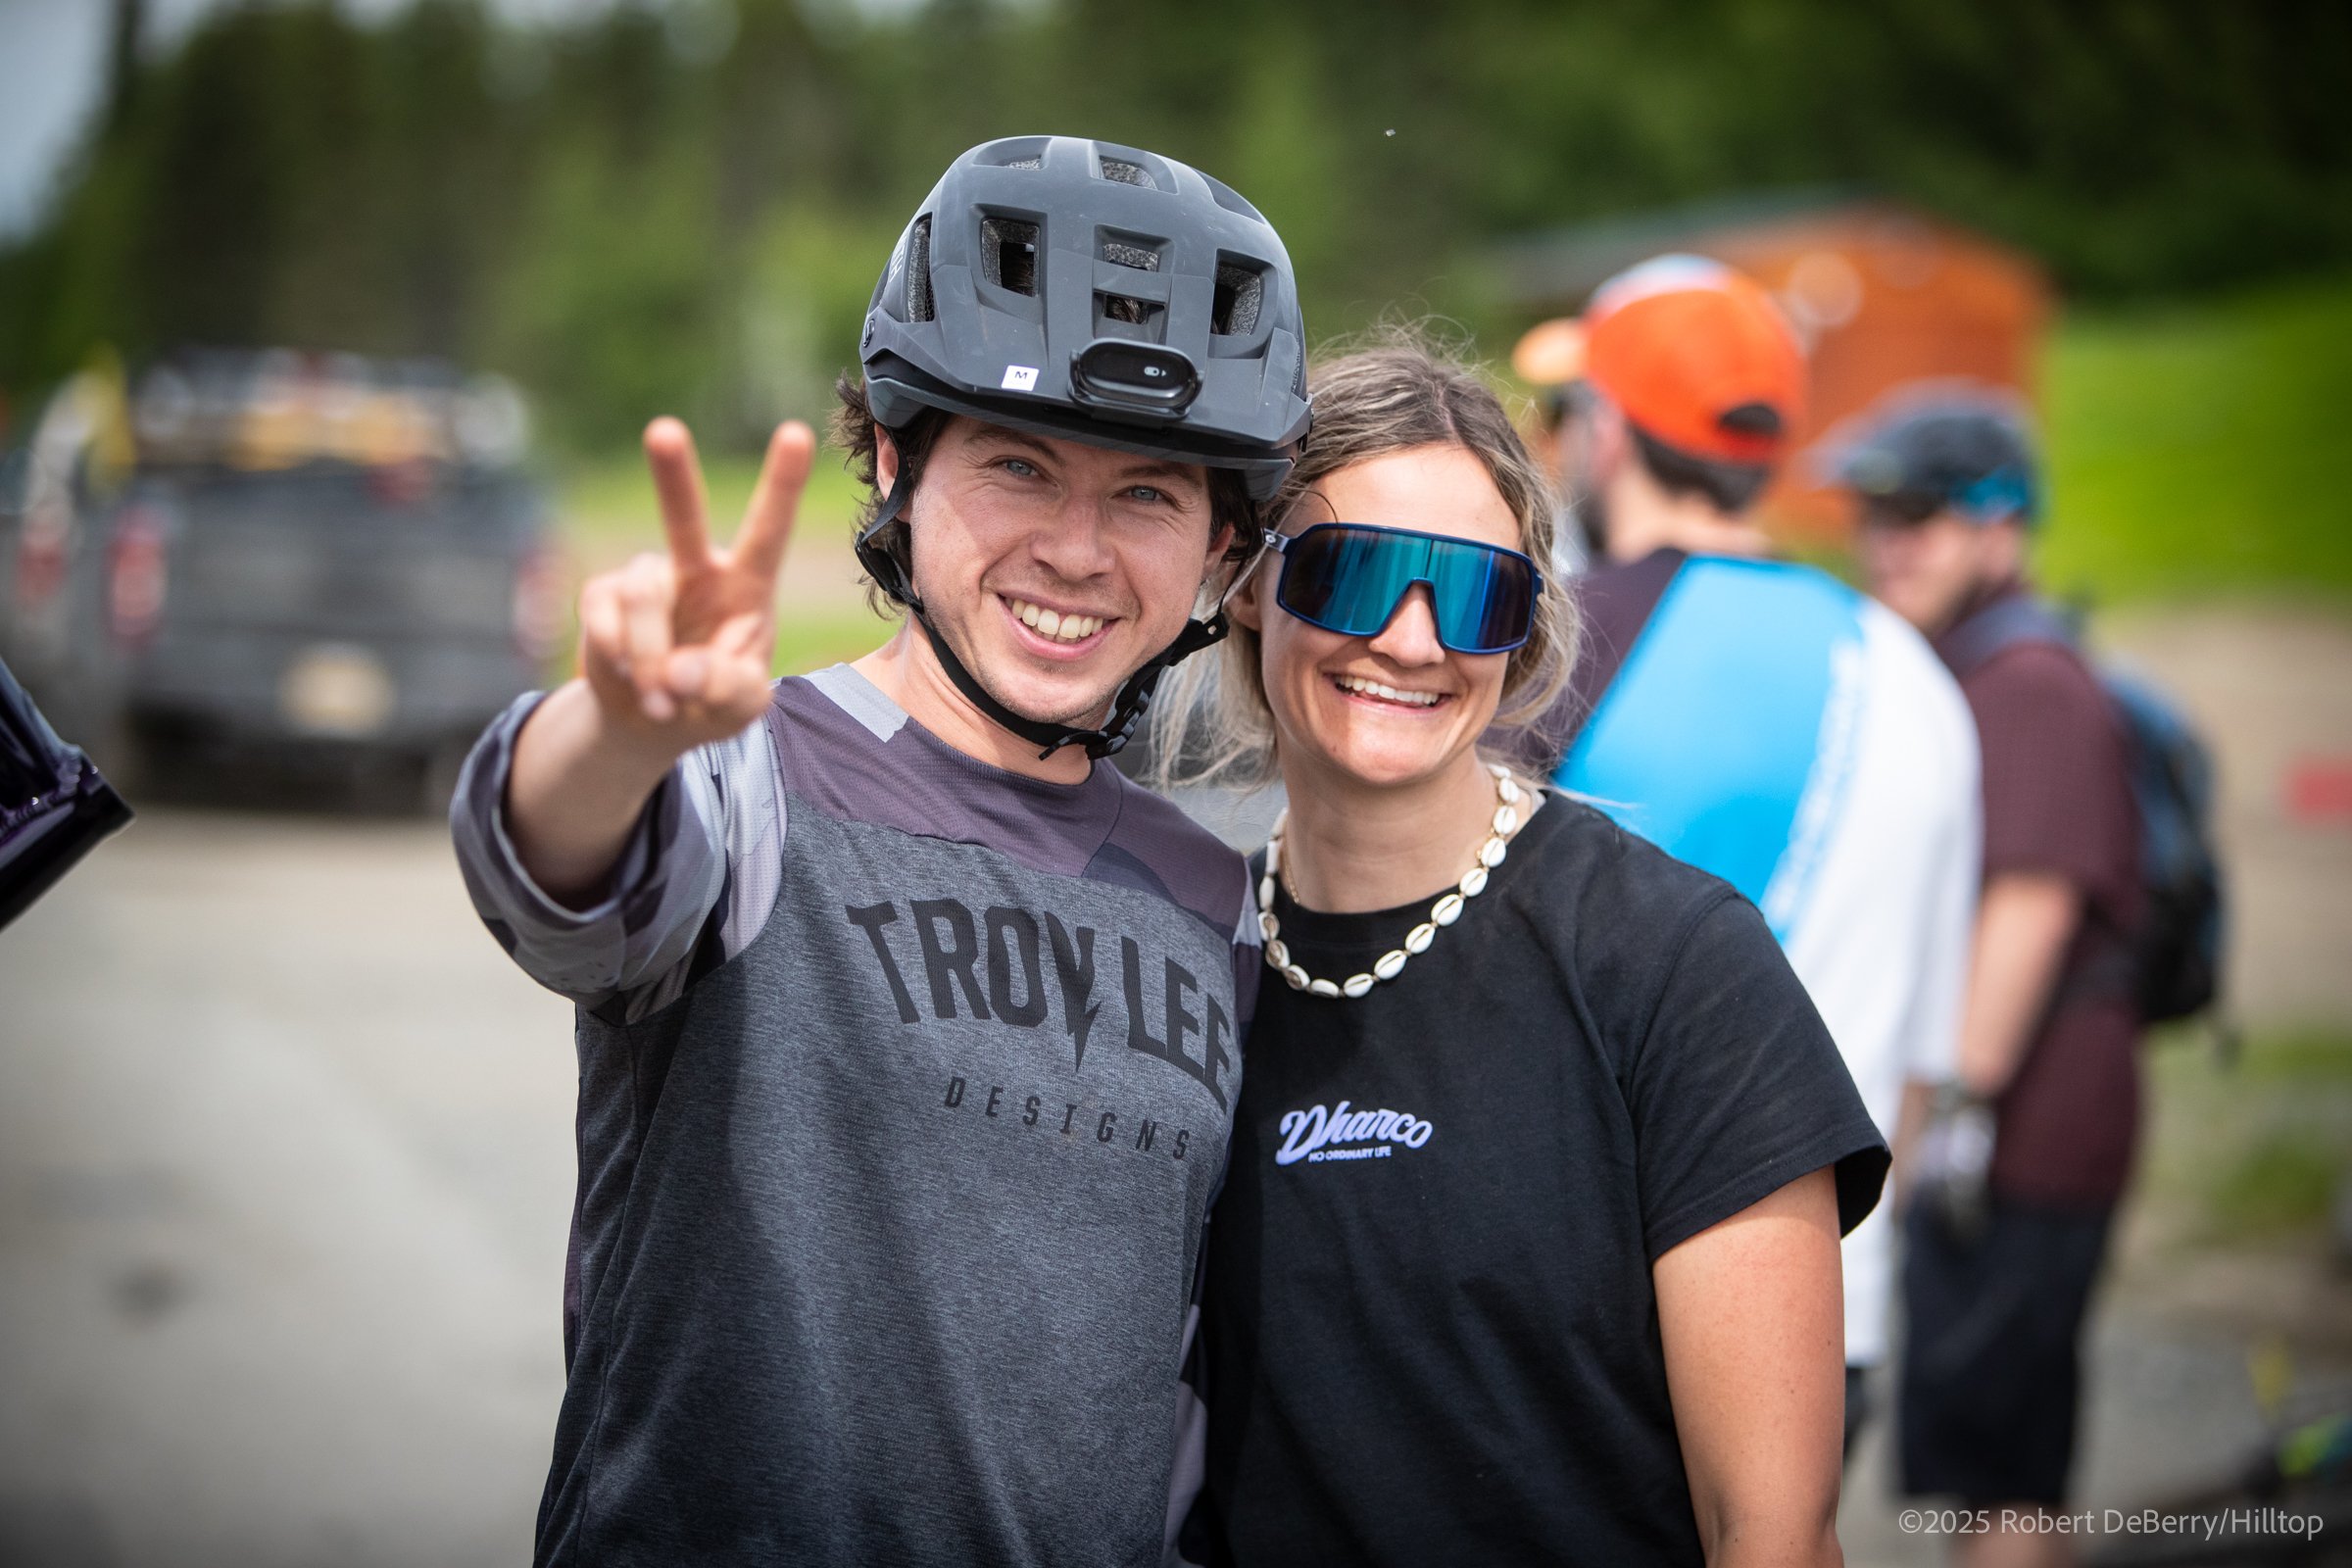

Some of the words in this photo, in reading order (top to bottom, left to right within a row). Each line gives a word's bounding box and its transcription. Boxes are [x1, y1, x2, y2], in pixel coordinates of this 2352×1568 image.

[1014, 370, 1028, 380] M
[845, 899, 1102, 1073] TROY
[1121, 936, 1230, 1113] LEE
[945, 1076, 1191, 1160] DESIGNS
[1276, 1101, 1433, 1165] Dharco
[1308, 1151, 1325, 1162] NO
[1326, 1148, 1374, 1161] ORDINARY
[1375, 1146, 1392, 1157] LIFE
